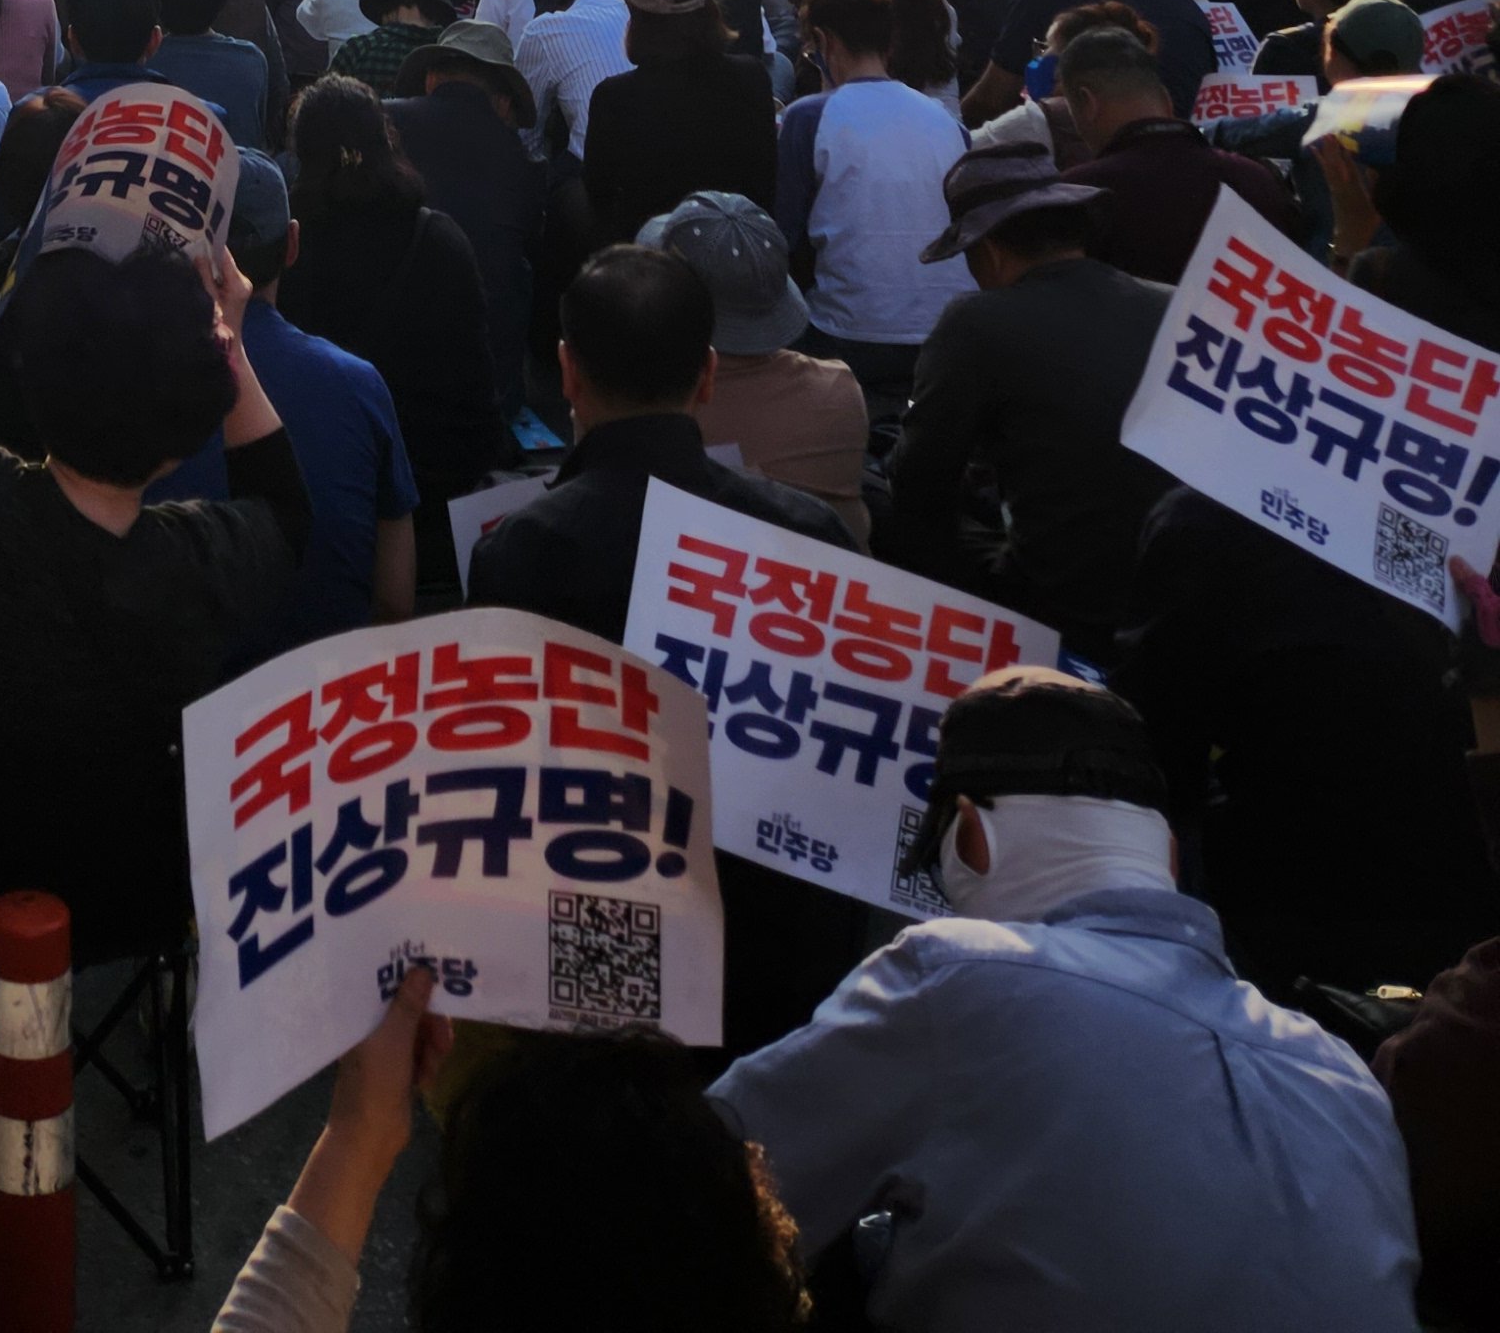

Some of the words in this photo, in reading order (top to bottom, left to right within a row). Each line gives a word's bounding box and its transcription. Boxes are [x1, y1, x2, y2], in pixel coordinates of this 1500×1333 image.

[1165, 314, 1500, 527] 진상규명!
[1206, 234, 1500, 438] 국정농단
[1260, 488, 1331, 546] 민주당
[666, 532, 1021, 703] 국정농단
[229, 640, 661, 831] 국정농단
[652, 632, 943, 807] 진상규
[227, 765, 694, 990] 진상규명!
[756, 818, 839, 874] 민주당
